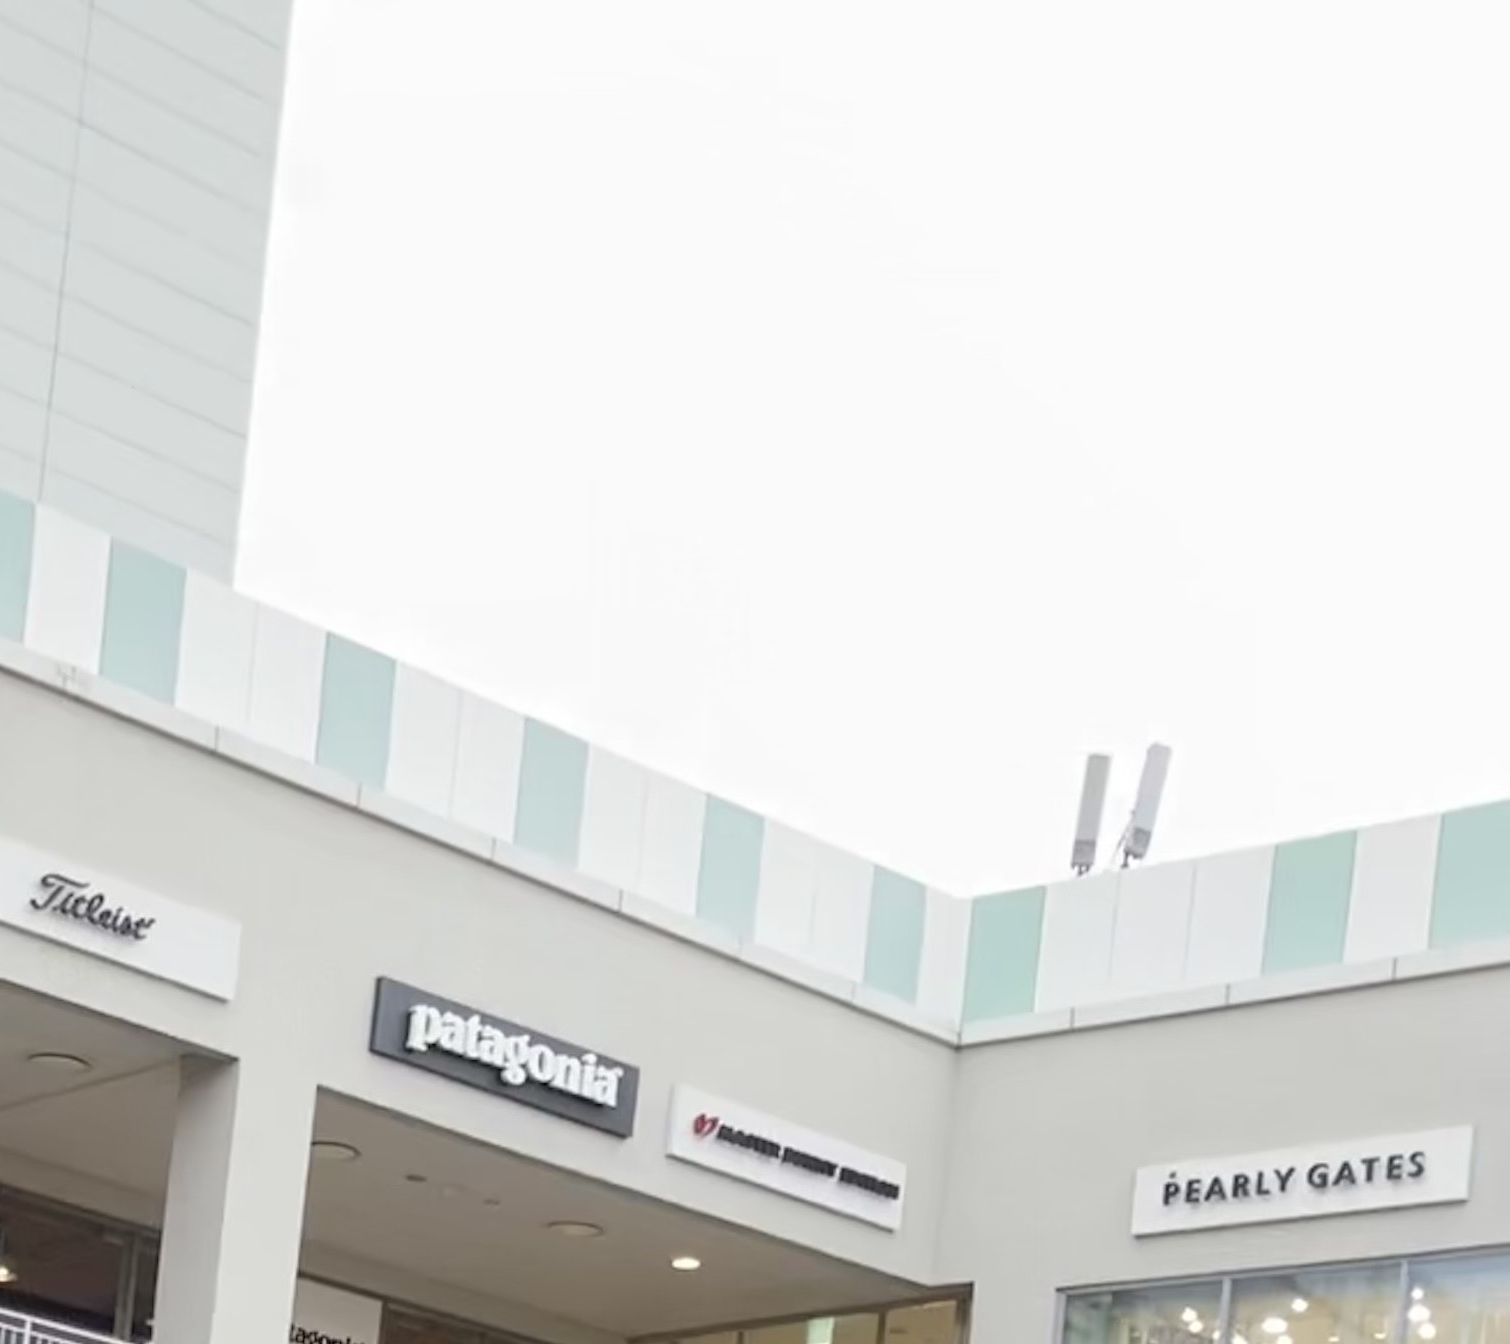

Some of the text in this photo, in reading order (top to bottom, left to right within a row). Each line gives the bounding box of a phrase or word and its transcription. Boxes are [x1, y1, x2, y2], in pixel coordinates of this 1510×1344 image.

[30, 873, 155, 940] Titleist
[405, 1004, 624, 1108] patagonia
[1163, 1151, 1425, 1206] PEARLY GATES
